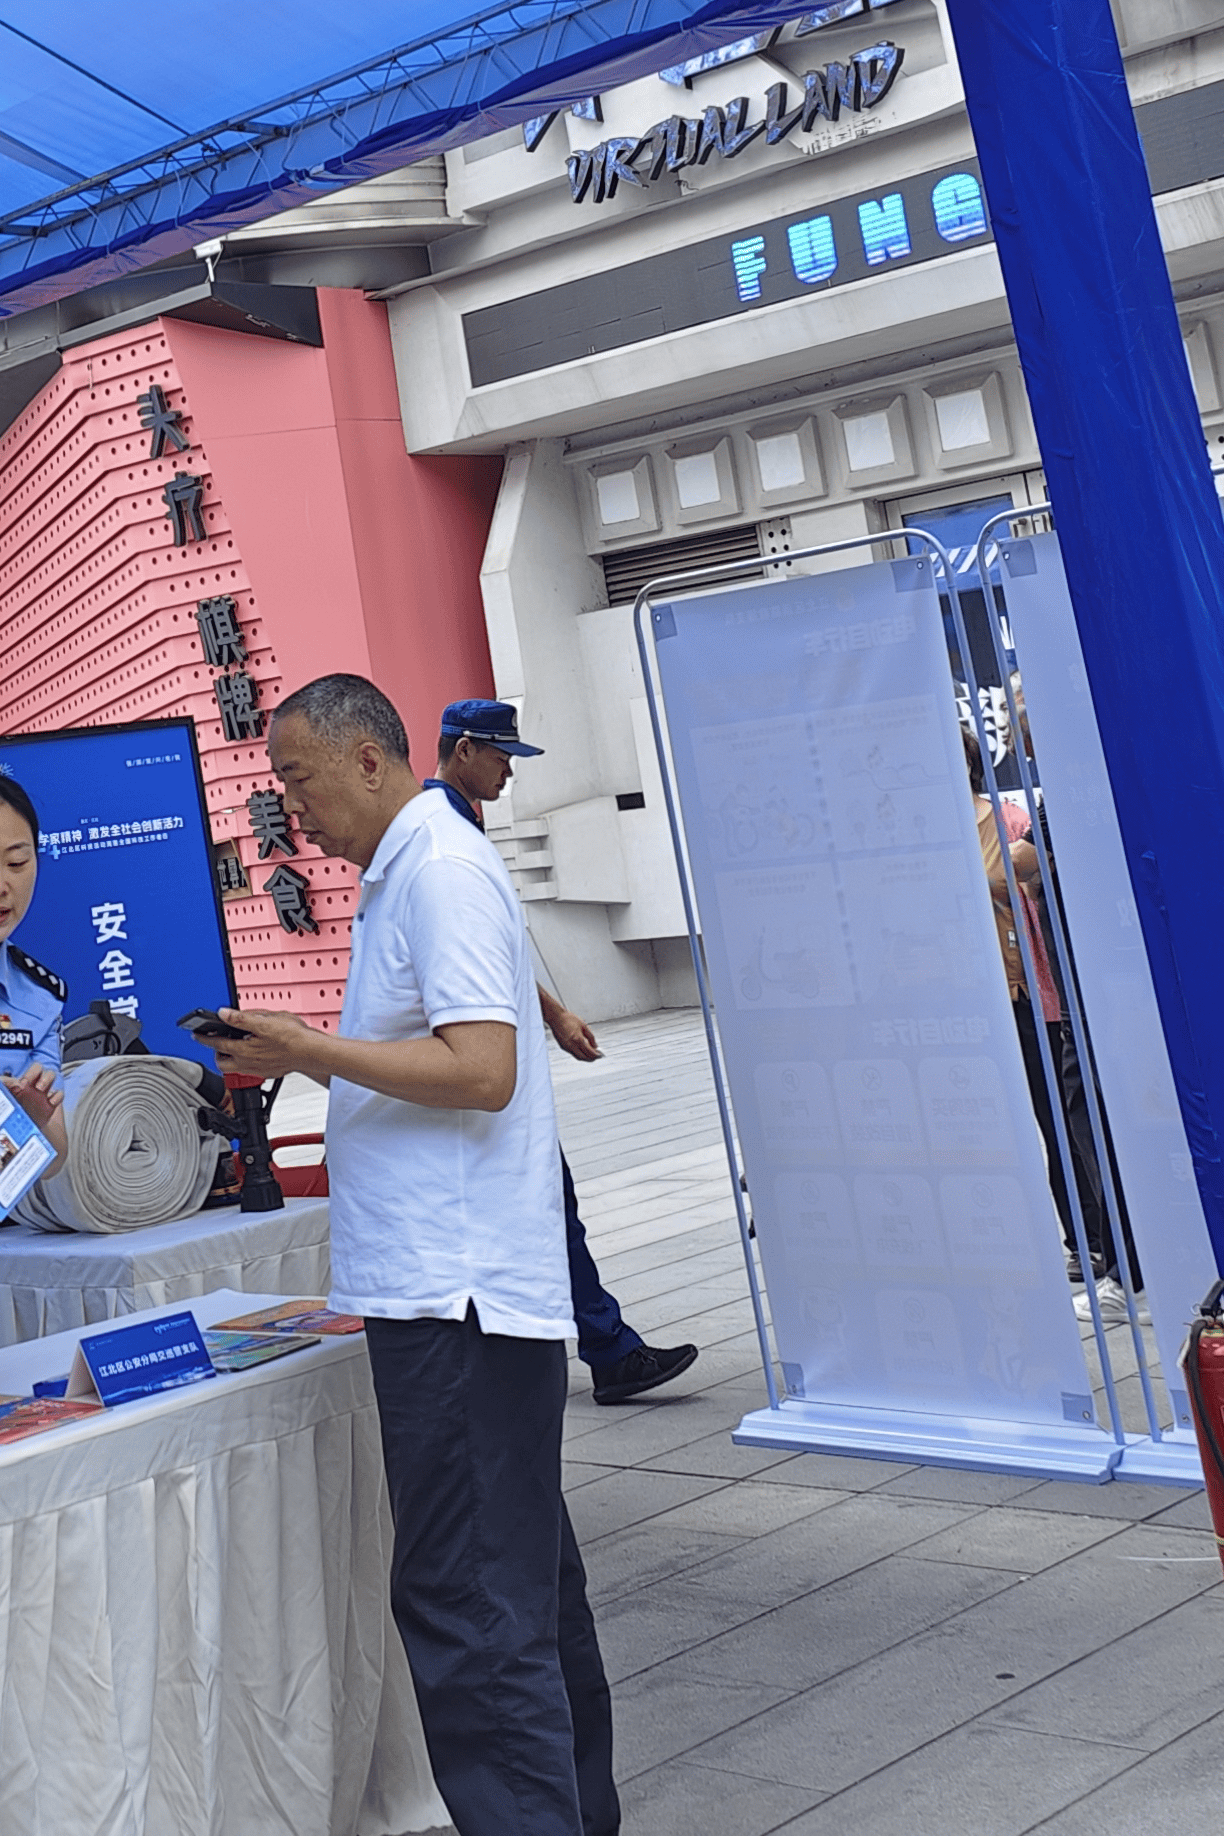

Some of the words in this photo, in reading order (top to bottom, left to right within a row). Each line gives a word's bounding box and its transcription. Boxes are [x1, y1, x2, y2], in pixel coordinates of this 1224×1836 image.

[137, 384, 208, 548] 头疗
[197, 594, 264, 742] 棋牌
[247, 788, 320, 935] 美食
